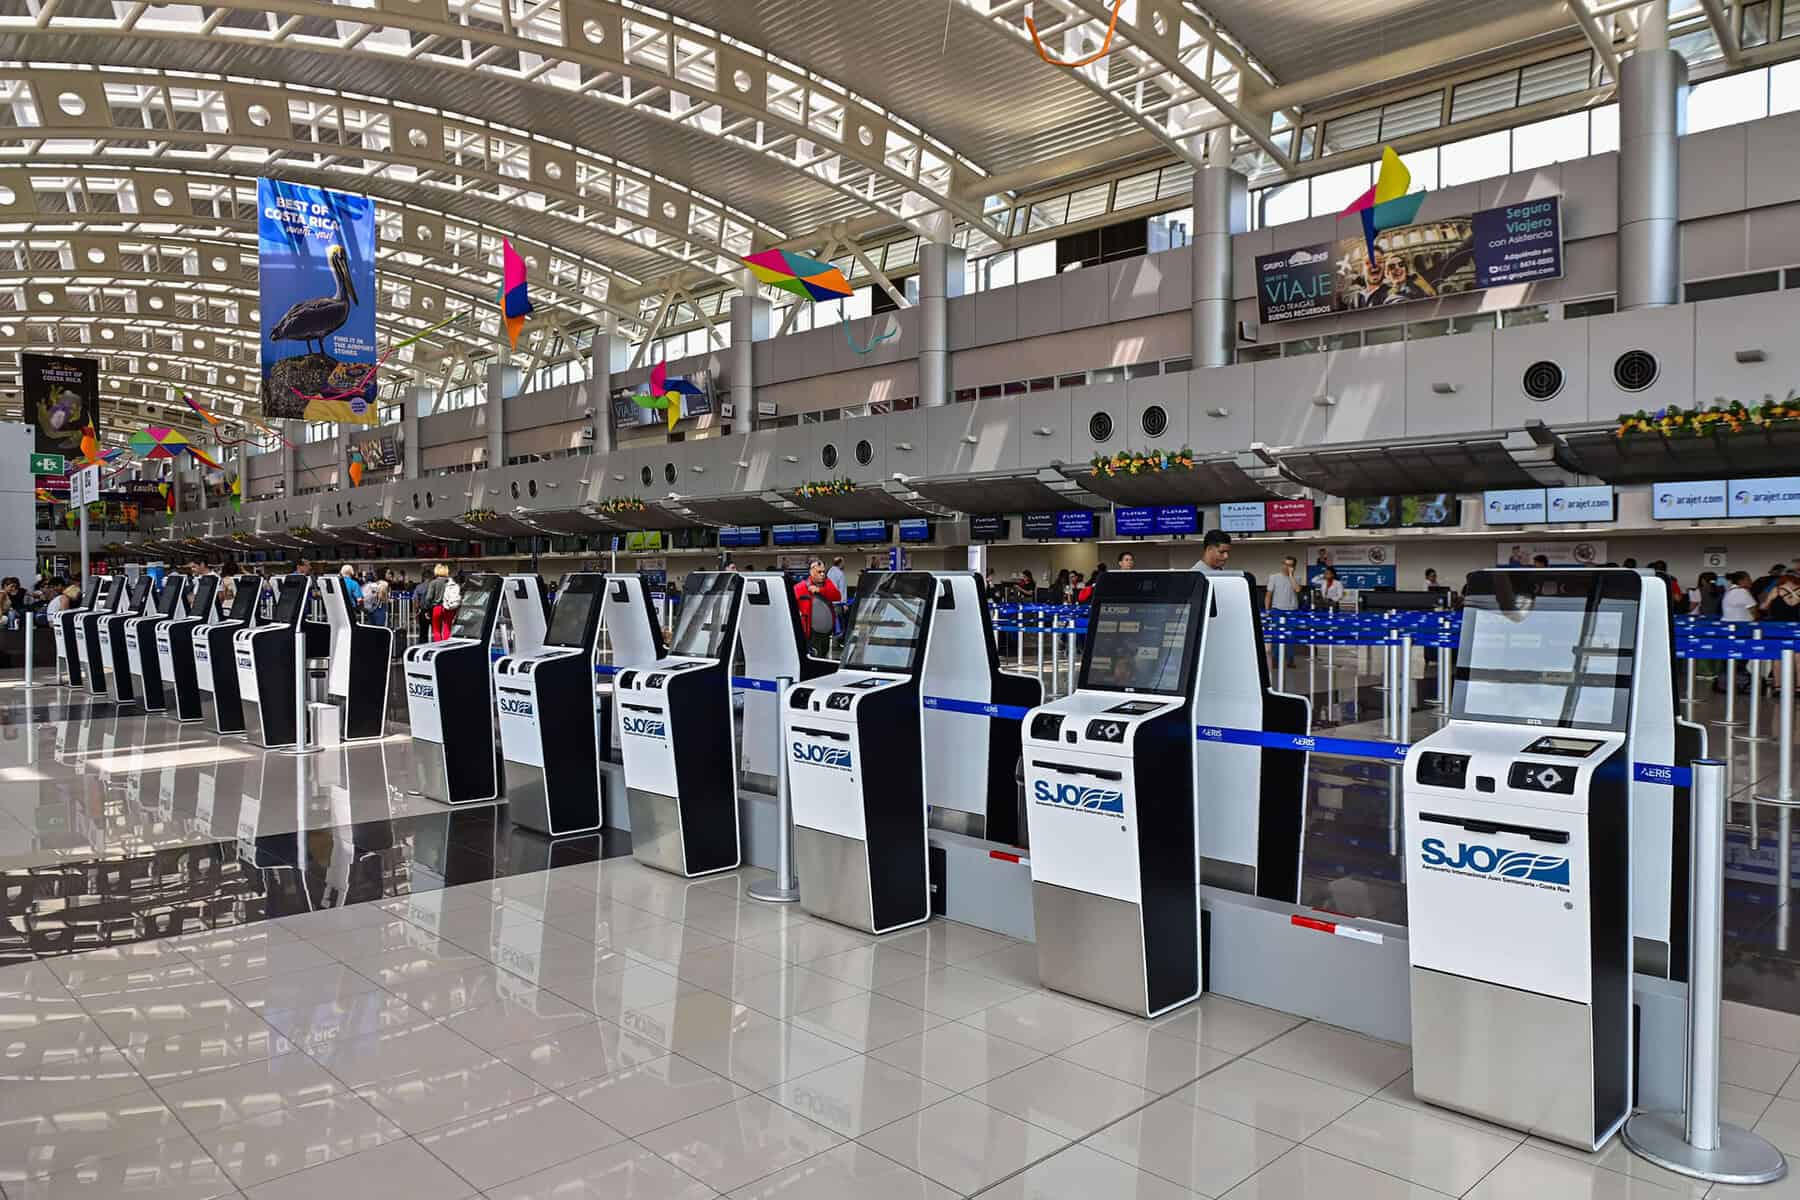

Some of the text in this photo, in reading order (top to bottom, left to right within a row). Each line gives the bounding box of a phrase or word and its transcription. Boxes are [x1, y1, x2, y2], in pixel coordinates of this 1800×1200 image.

[277, 196, 329, 216] BEST OF
[1506, 203, 1552, 218] Seguro
[264, 207, 339, 231] COSTA RICA
[1506, 218, 1553, 233] Viajero
[1488, 230, 1553, 248] con Asistencia
[1263, 261, 1284, 271] GRUPO
[1265, 273, 1332, 304] VIAJE
[1267, 299, 1314, 314] SOLO TRAIGAS
[1268, 305, 1331, 321] BUENOS RECUERDOS
[1503, 501, 1543, 512] arajet.com
[1567, 498, 1609, 510] arajet.com
[1677, 494, 1724, 507] arajet.com
[501, 698, 518, 712] SJO
[623, 717, 645, 732] SJO
[793, 742, 823, 762] SJO
[1640, 767, 1672, 779] AERIS
[1034, 780, 1080, 806] SJO
[1421, 837, 1497, 873] SJO
[1422, 864, 1451, 873] Aeropuerto
[1452, 870, 1487, 880] Internacional
[1488, 873, 1501, 881] Juan
[1539, 883, 1556, 891] Costa
